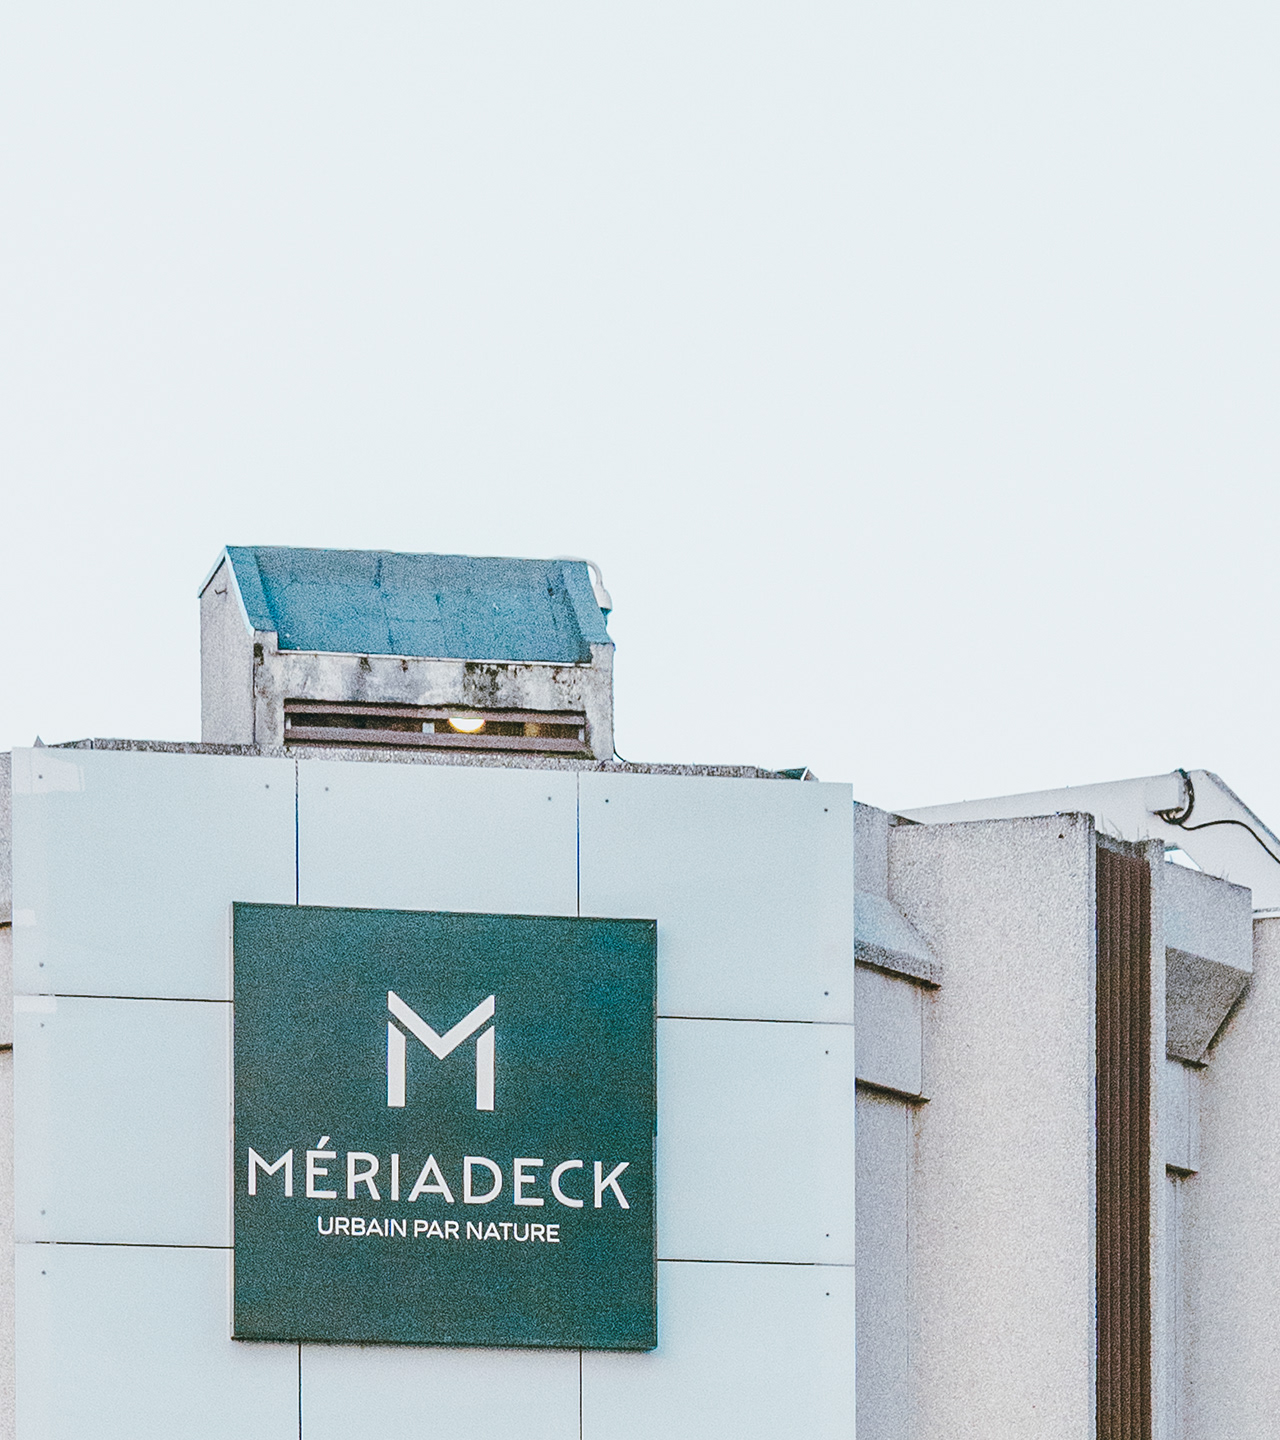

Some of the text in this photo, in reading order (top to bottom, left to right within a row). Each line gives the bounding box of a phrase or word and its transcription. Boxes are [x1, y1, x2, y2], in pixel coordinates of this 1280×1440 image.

[247, 1136, 630, 1210] MÉRIADECK
[317, 1216, 561, 1243] URBAIN PAR NATURE
